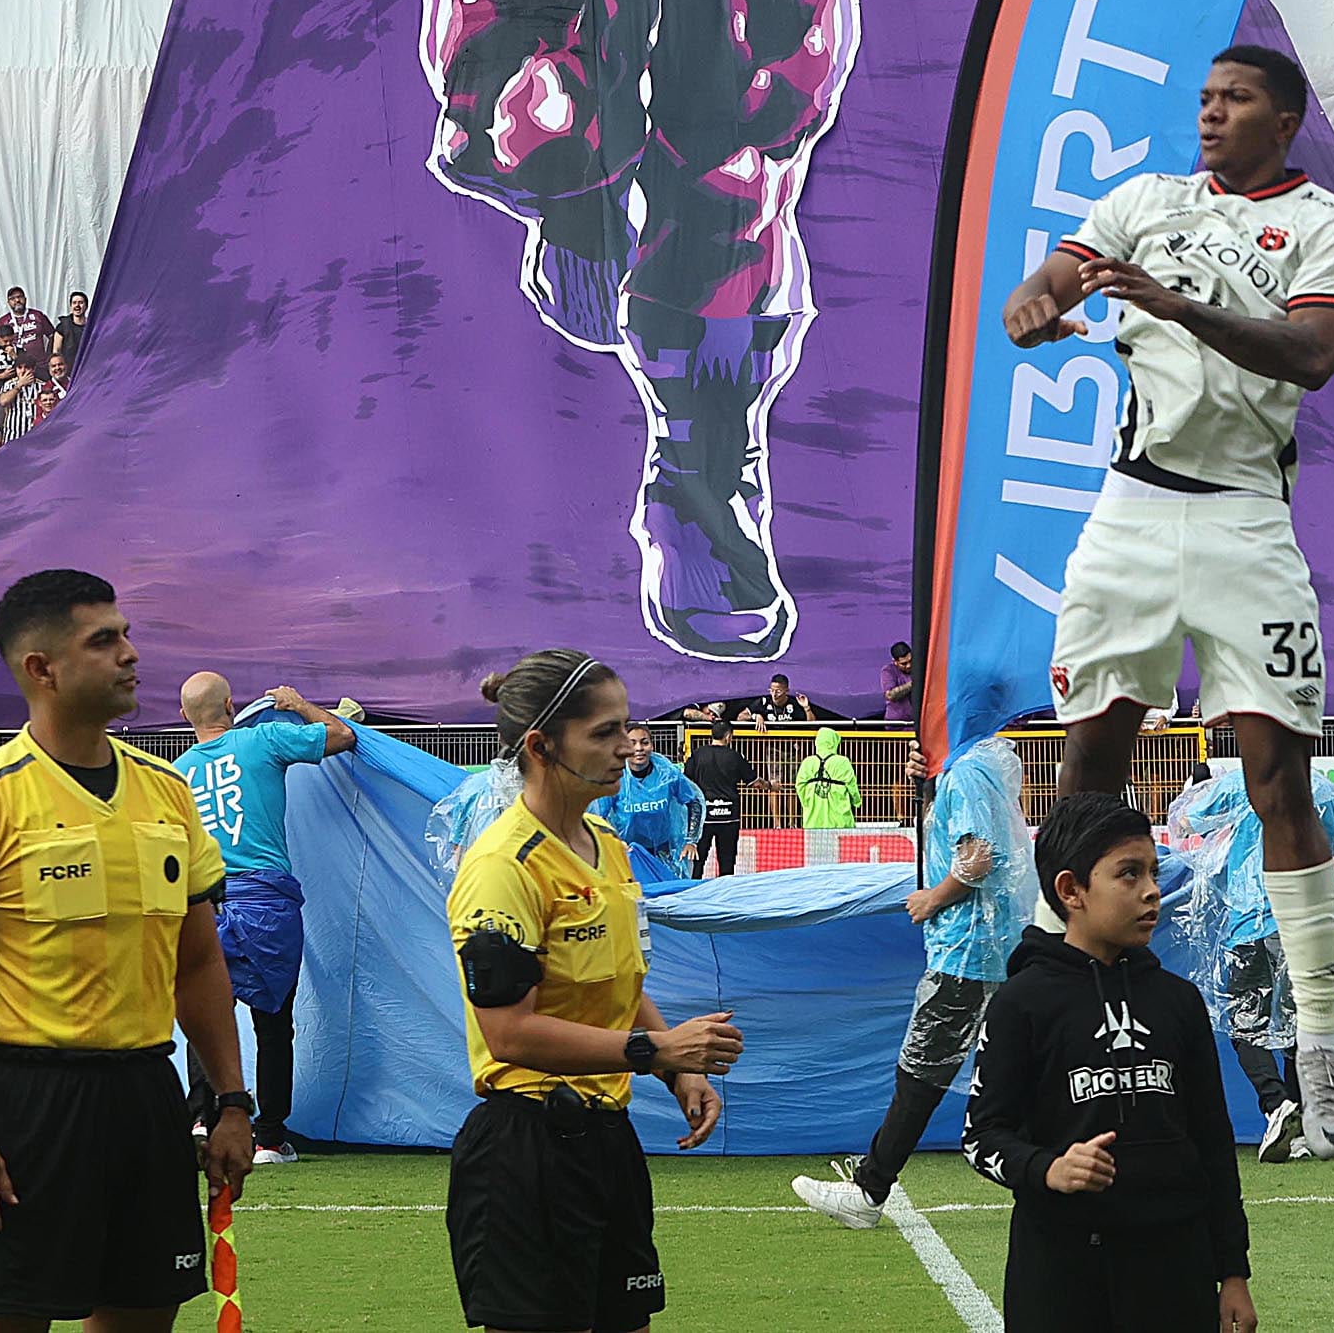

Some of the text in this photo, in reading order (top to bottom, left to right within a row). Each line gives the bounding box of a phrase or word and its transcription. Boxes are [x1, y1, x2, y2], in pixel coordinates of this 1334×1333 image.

[1261, 621, 1323, 679] 32
[38, 862, 92, 882] FCRF
[563, 923, 606, 942] FCRF
[1071, 1062, 1172, 1100] PIONEER
